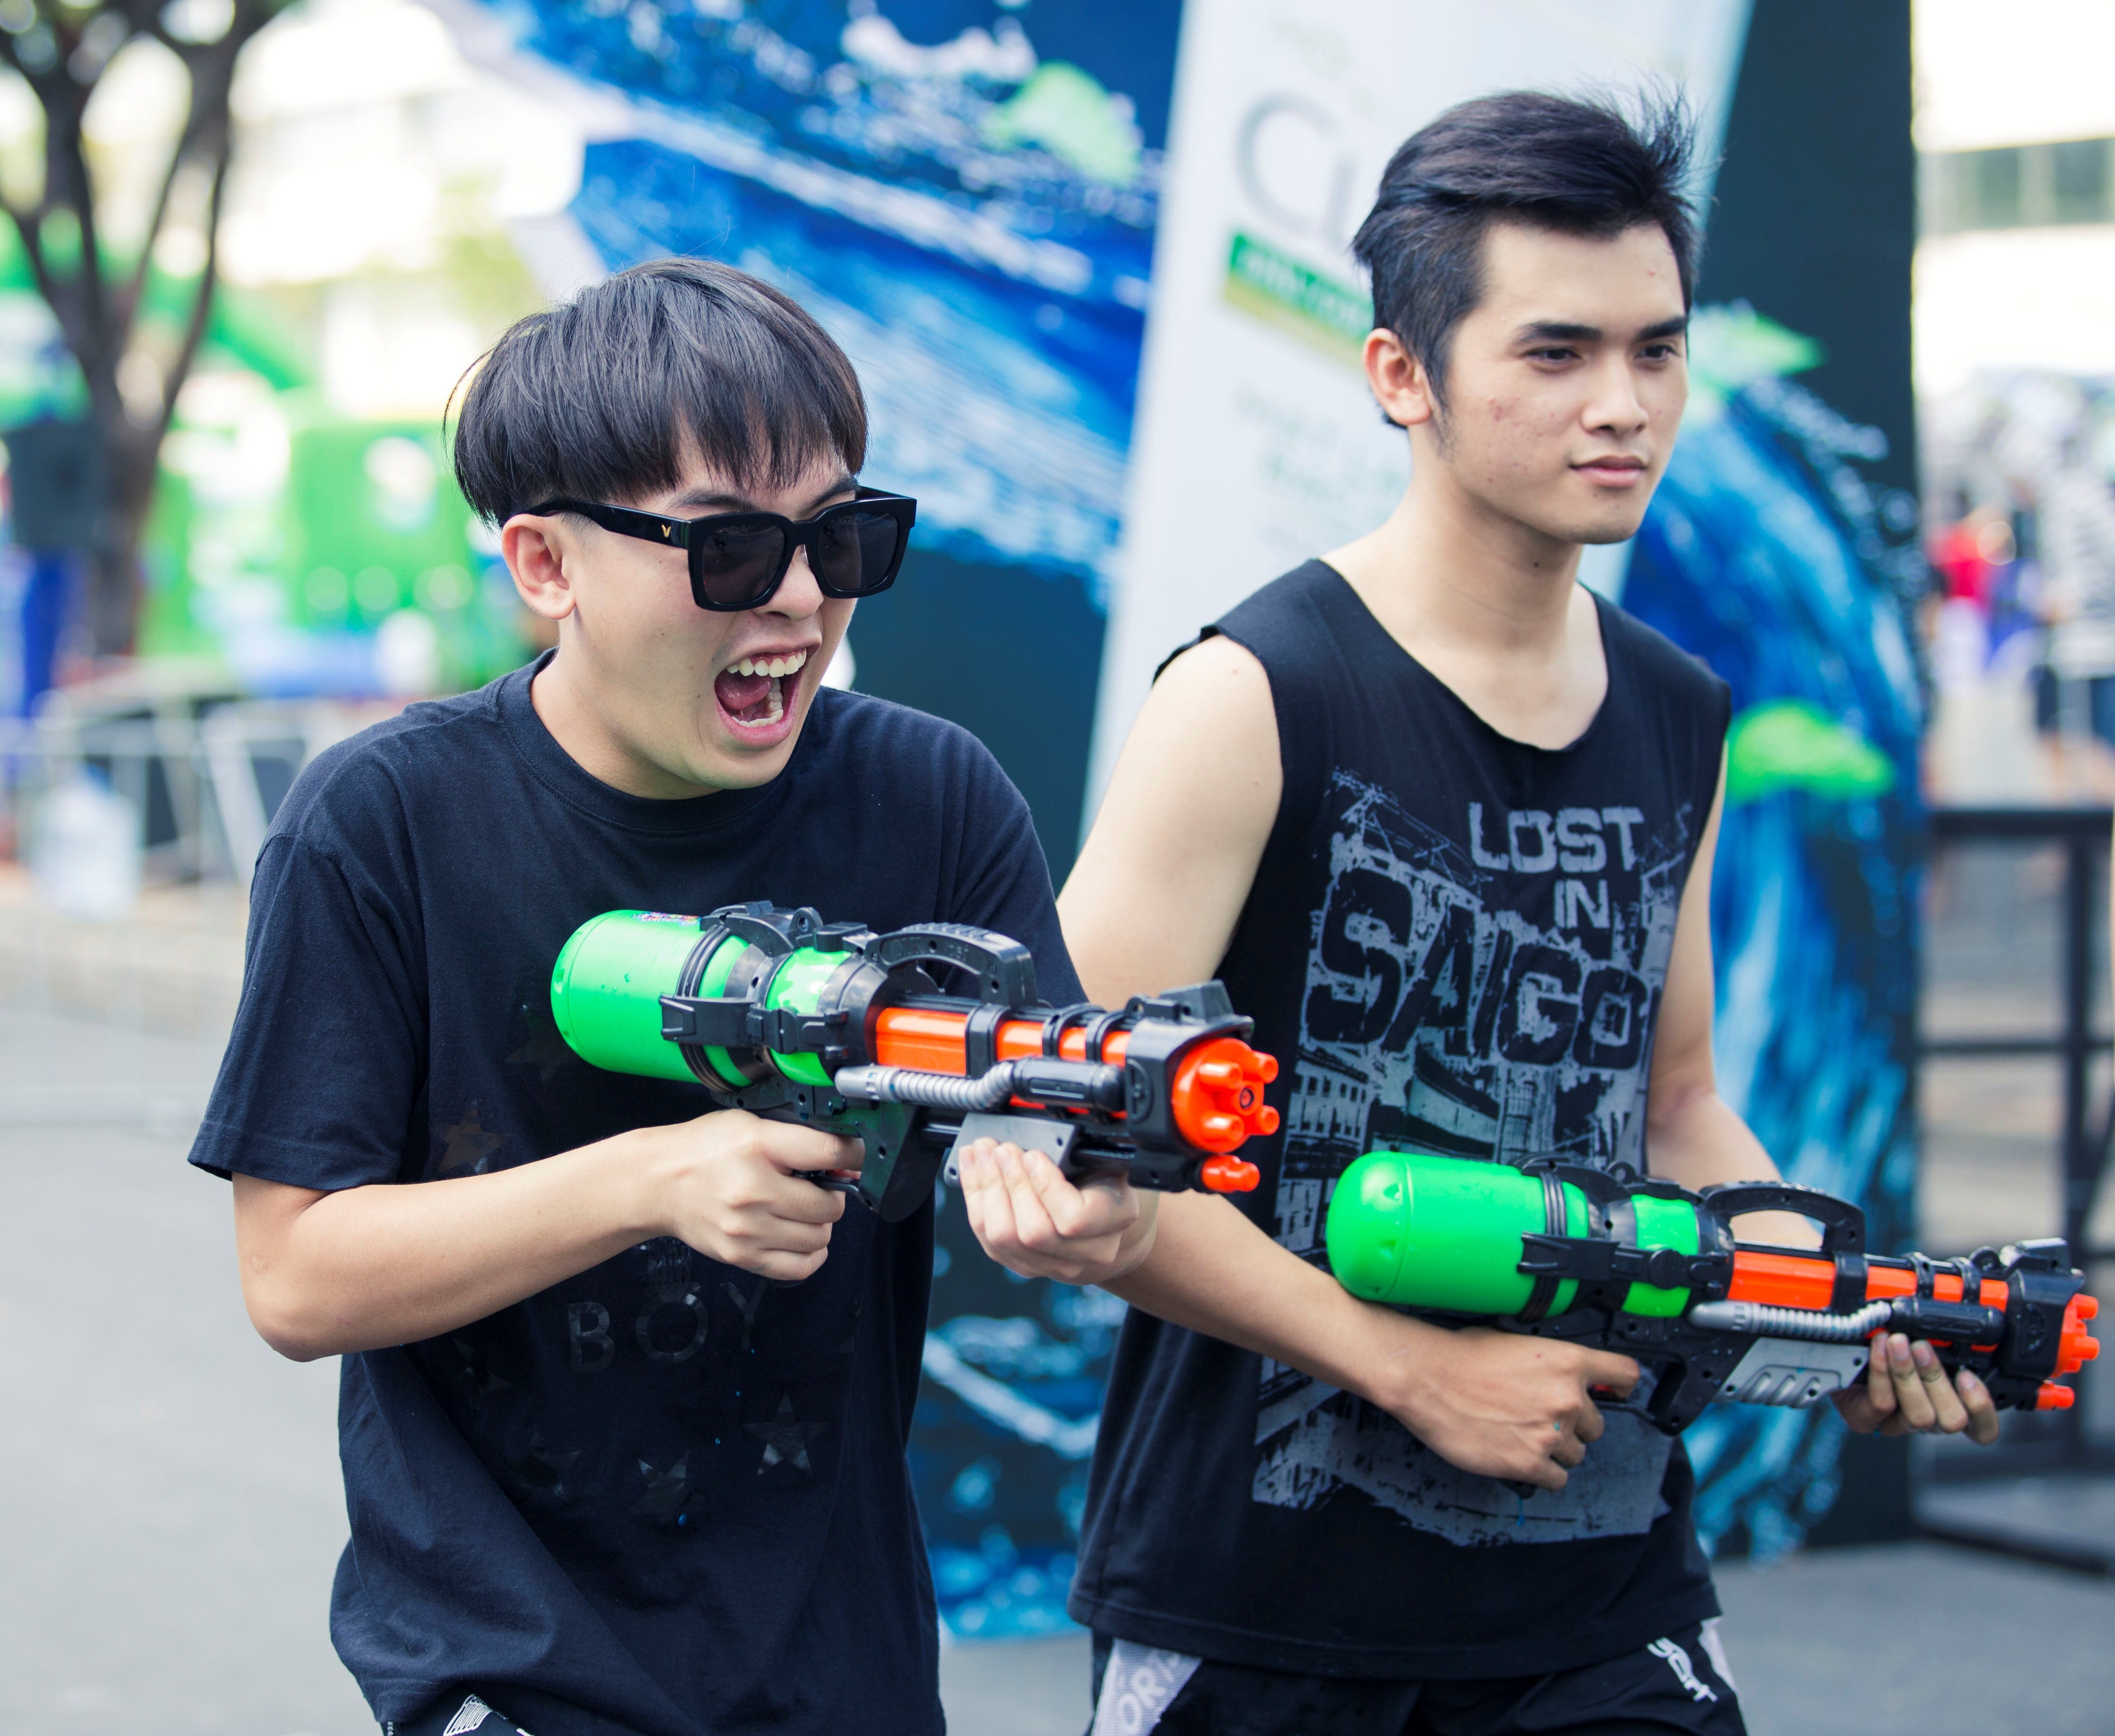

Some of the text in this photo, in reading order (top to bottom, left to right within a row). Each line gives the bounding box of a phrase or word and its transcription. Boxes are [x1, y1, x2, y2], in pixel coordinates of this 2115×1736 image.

[1468, 802, 1646, 873] LOST
[1554, 878, 1611, 929] IN
[1303, 867, 1656, 1070] SAIGO
[567, 1282, 768, 1375] BOY
